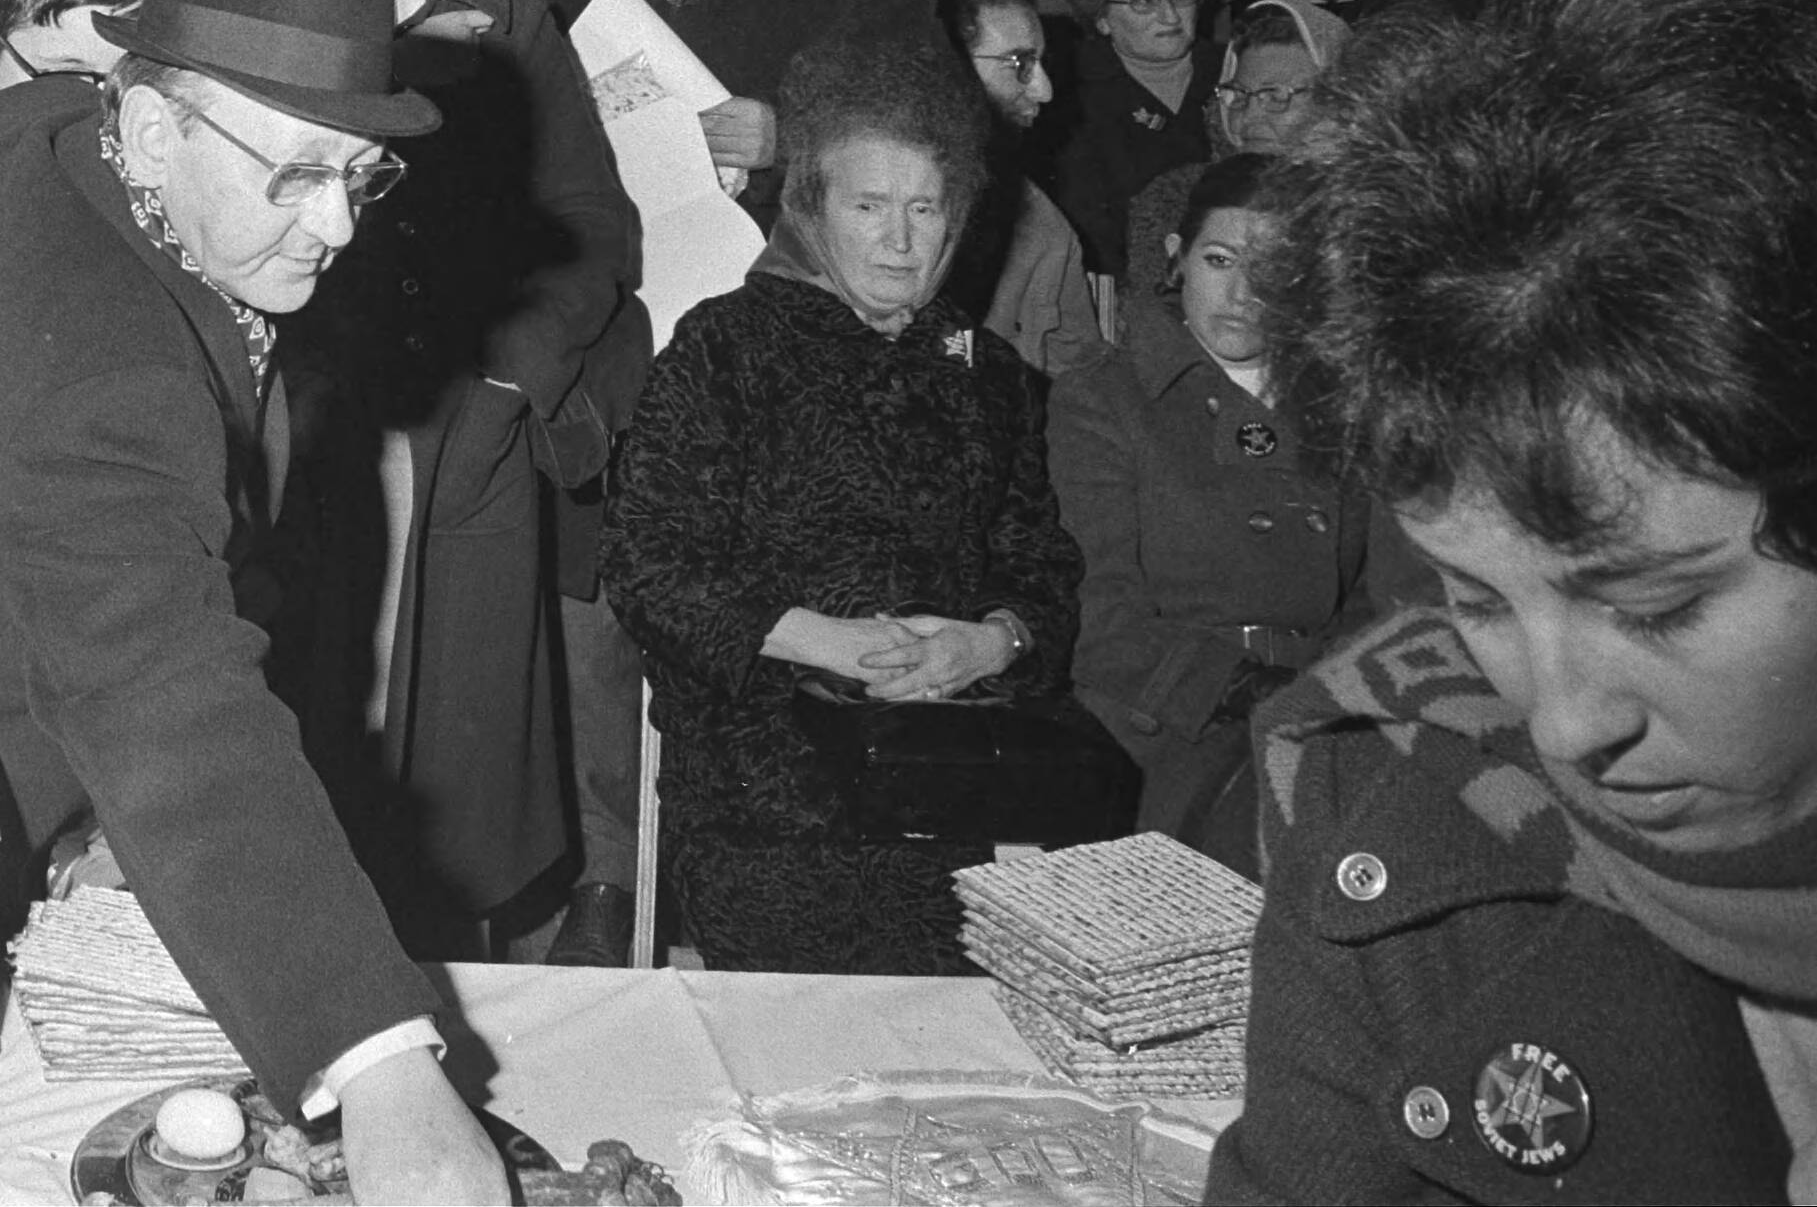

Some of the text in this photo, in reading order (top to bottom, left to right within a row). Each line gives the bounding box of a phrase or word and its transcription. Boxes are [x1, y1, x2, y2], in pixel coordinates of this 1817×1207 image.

[1511, 1043, 1571, 1084] FREE
[1474, 1098, 1567, 1166] SOVIET JEWS
